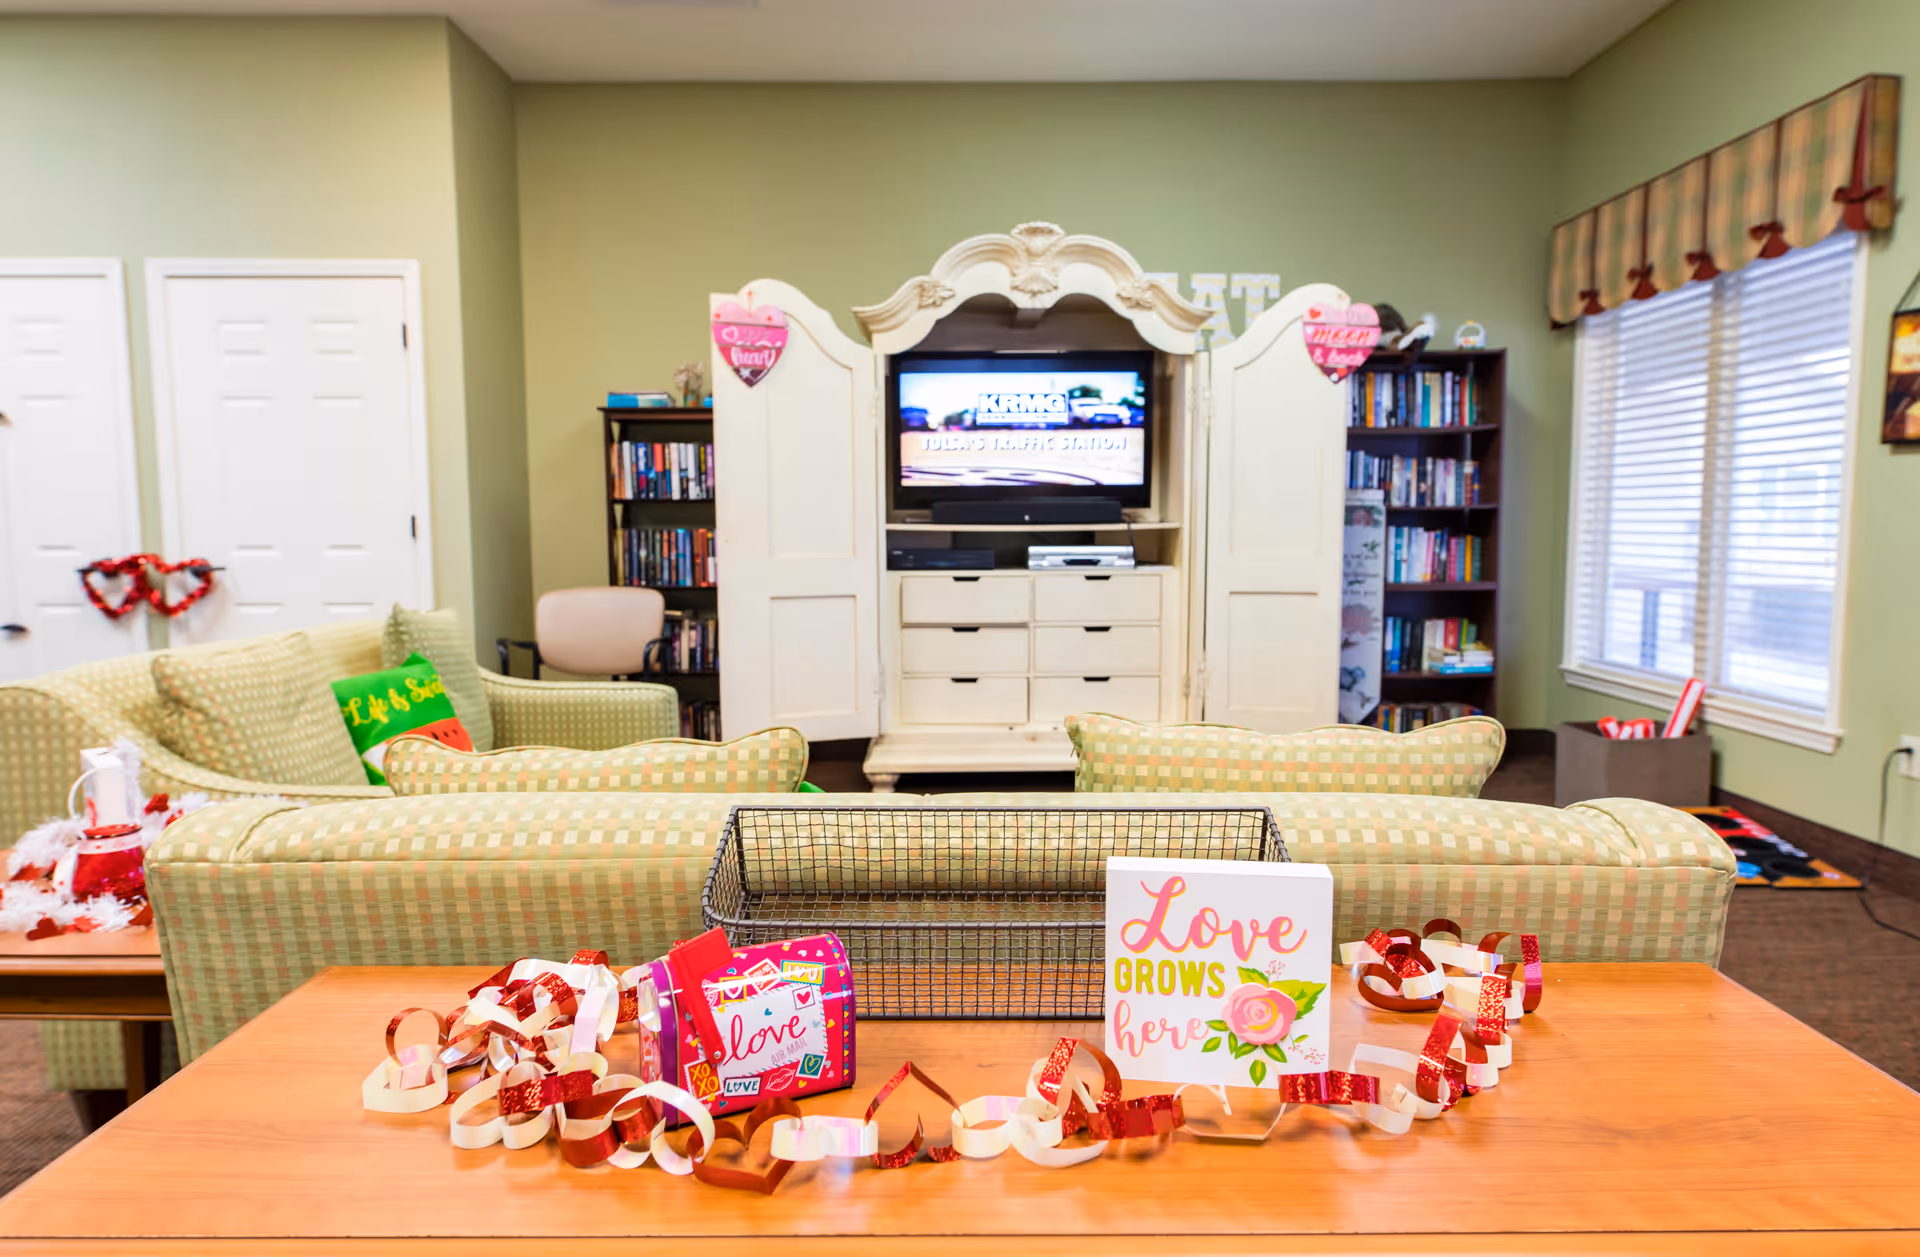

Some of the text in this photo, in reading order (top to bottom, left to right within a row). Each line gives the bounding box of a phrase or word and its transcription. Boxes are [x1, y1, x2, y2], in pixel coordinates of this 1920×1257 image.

[1143, 272, 1281, 351] AT
[979, 393, 1066, 412] KRMG
[922, 436, 1128, 450] TULSA'S TRAFFIC STATION
[1120, 875, 1308, 962] Love
[1114, 957, 1226, 999] GROWS
[722, 1014, 807, 1067] love
[1113, 999, 1210, 1058] here
[771, 1036, 809, 1065] AIR MAIL
[689, 1063, 711, 1081] XO
[697, 1076, 719, 1097] XO
[726, 1080, 759, 1093] LOVE
